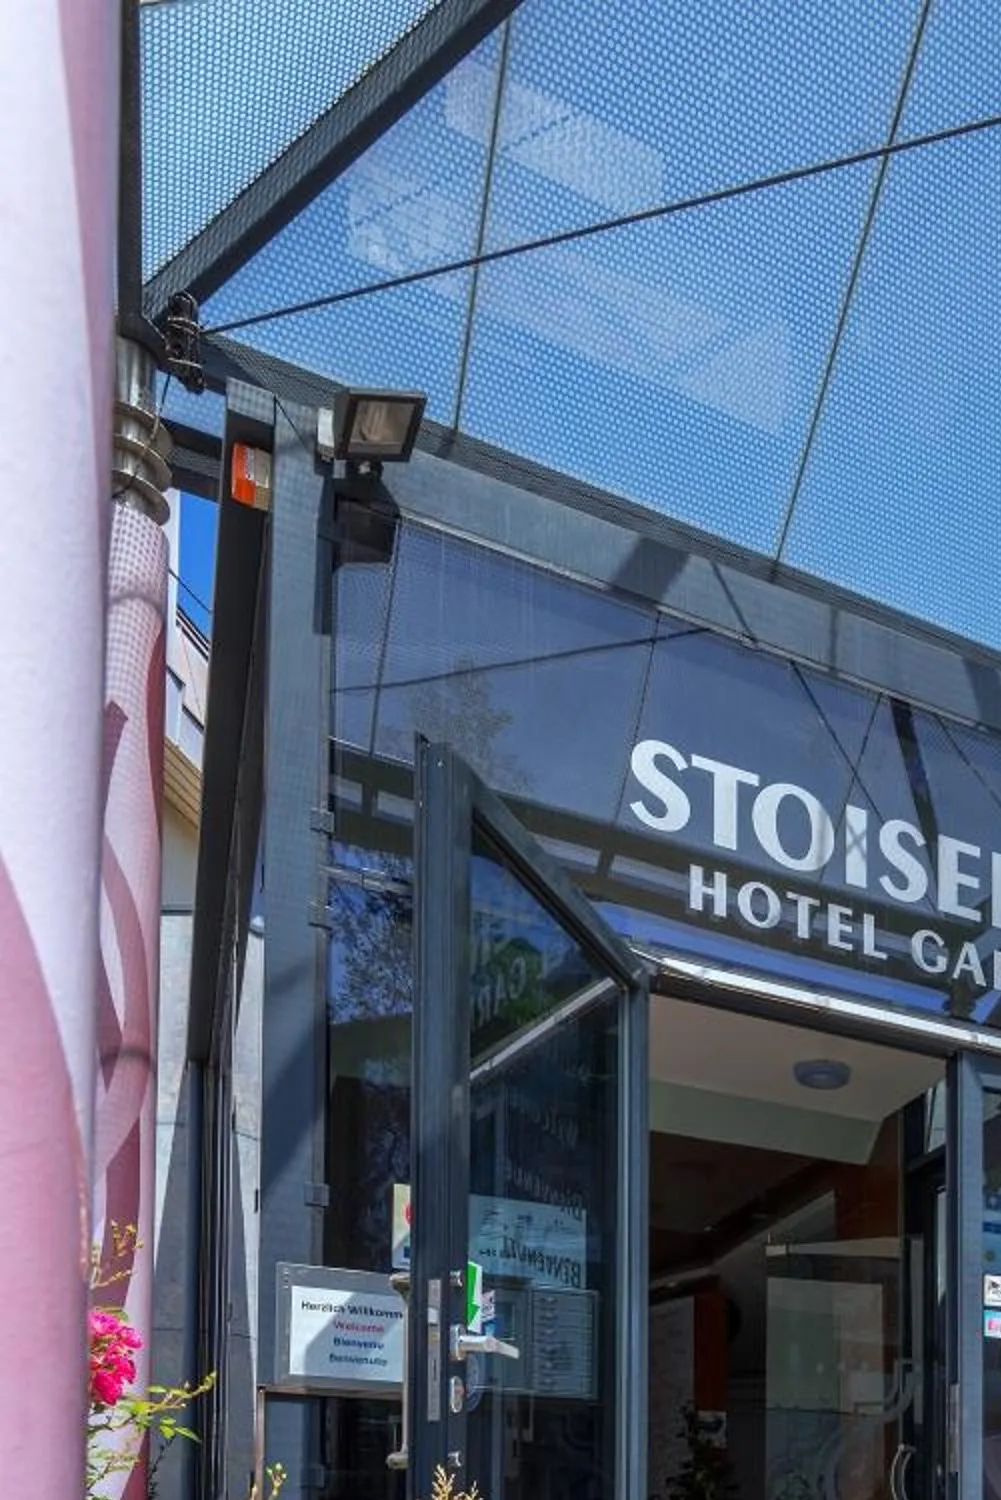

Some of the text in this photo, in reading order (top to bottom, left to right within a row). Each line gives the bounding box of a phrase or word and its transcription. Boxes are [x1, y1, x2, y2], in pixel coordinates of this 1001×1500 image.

[689, 863, 888, 960] HOTEL
[301, 1300, 404, 1320] Herzlich Willkomm
[333, 1320, 386, 1334] Welcome
